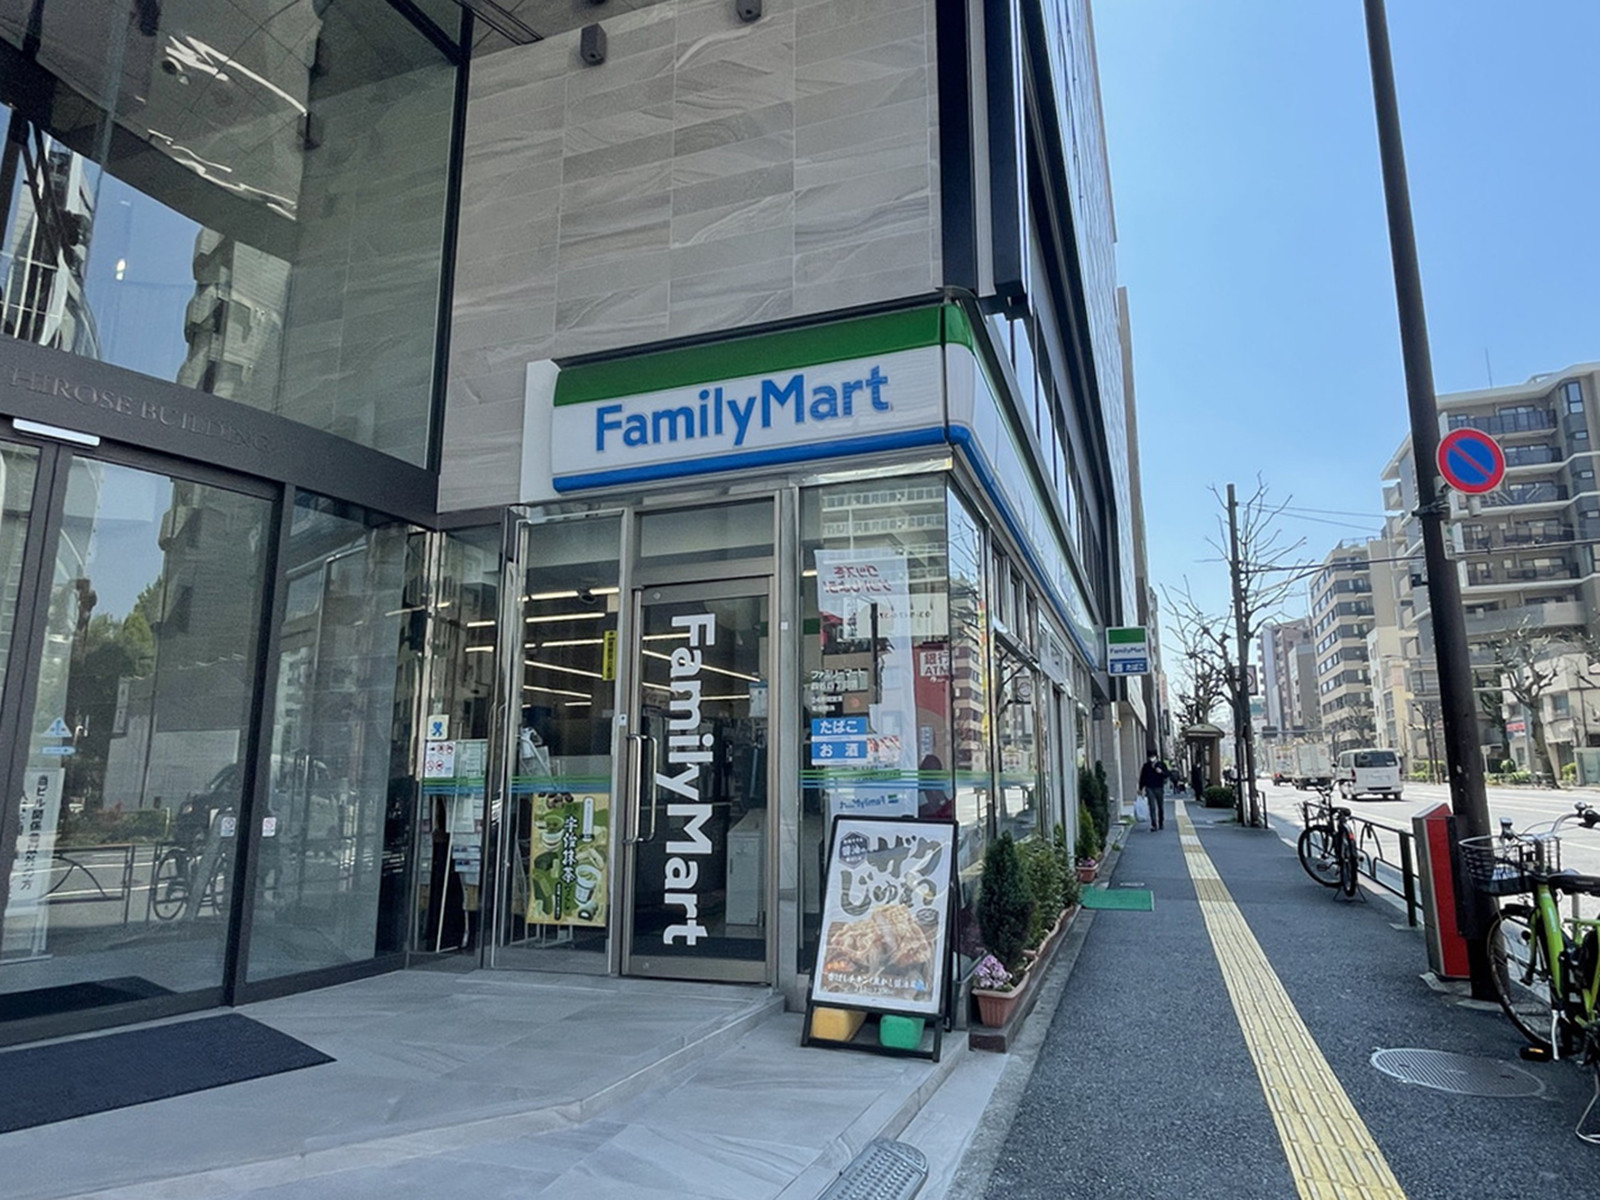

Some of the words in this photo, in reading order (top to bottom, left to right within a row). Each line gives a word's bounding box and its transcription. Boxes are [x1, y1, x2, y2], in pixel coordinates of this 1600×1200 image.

[8, 367, 132, 416] HIROSE
[140, 401, 270, 450] BUILDING
[595, 365, 890, 453] FamilyMart
[819, 720, 859, 735] たばこ
[655, 613, 716, 946] FamilyMart
[562, 815, 578, 883] 宇治抹茶
